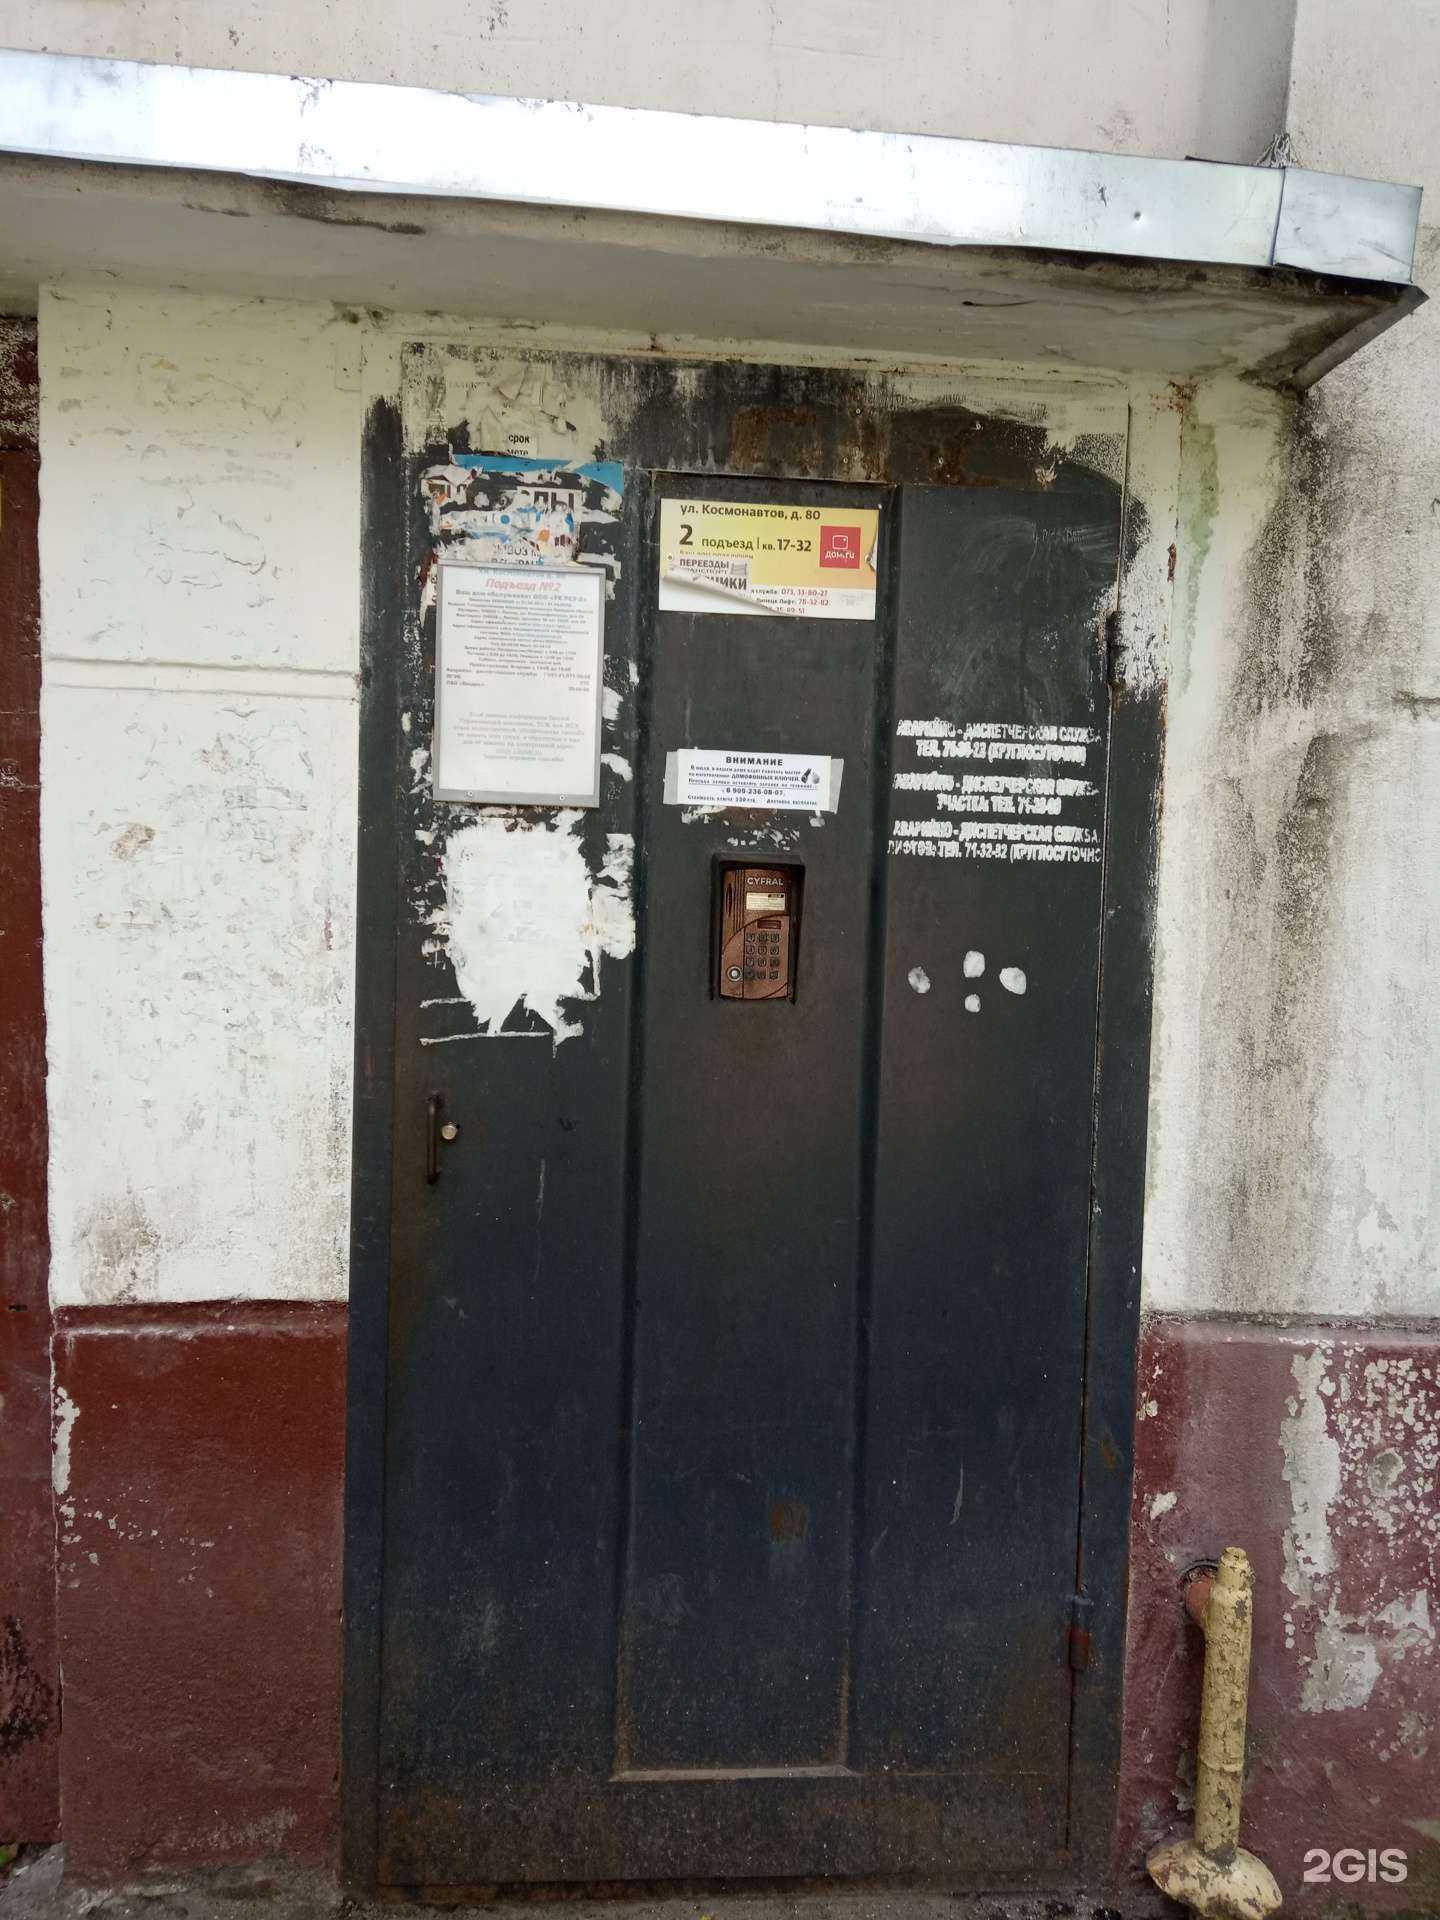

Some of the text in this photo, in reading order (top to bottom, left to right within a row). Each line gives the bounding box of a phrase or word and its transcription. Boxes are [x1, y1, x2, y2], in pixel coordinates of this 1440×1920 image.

[508, 434, 530, 444] срок
[680, 503, 821, 520] ул. Космонавтов, д. 80
[678, 524, 812, 552] 2 подъезд кв. 17-32
[679, 558, 730, 569] ПЕРЕЕЗДЫ
[485, 578, 562, 592] Подъезд №2
[725, 756, 783, 767] ВНИМАНИЕ
[747, 877, 784, 886] CYFRAL
